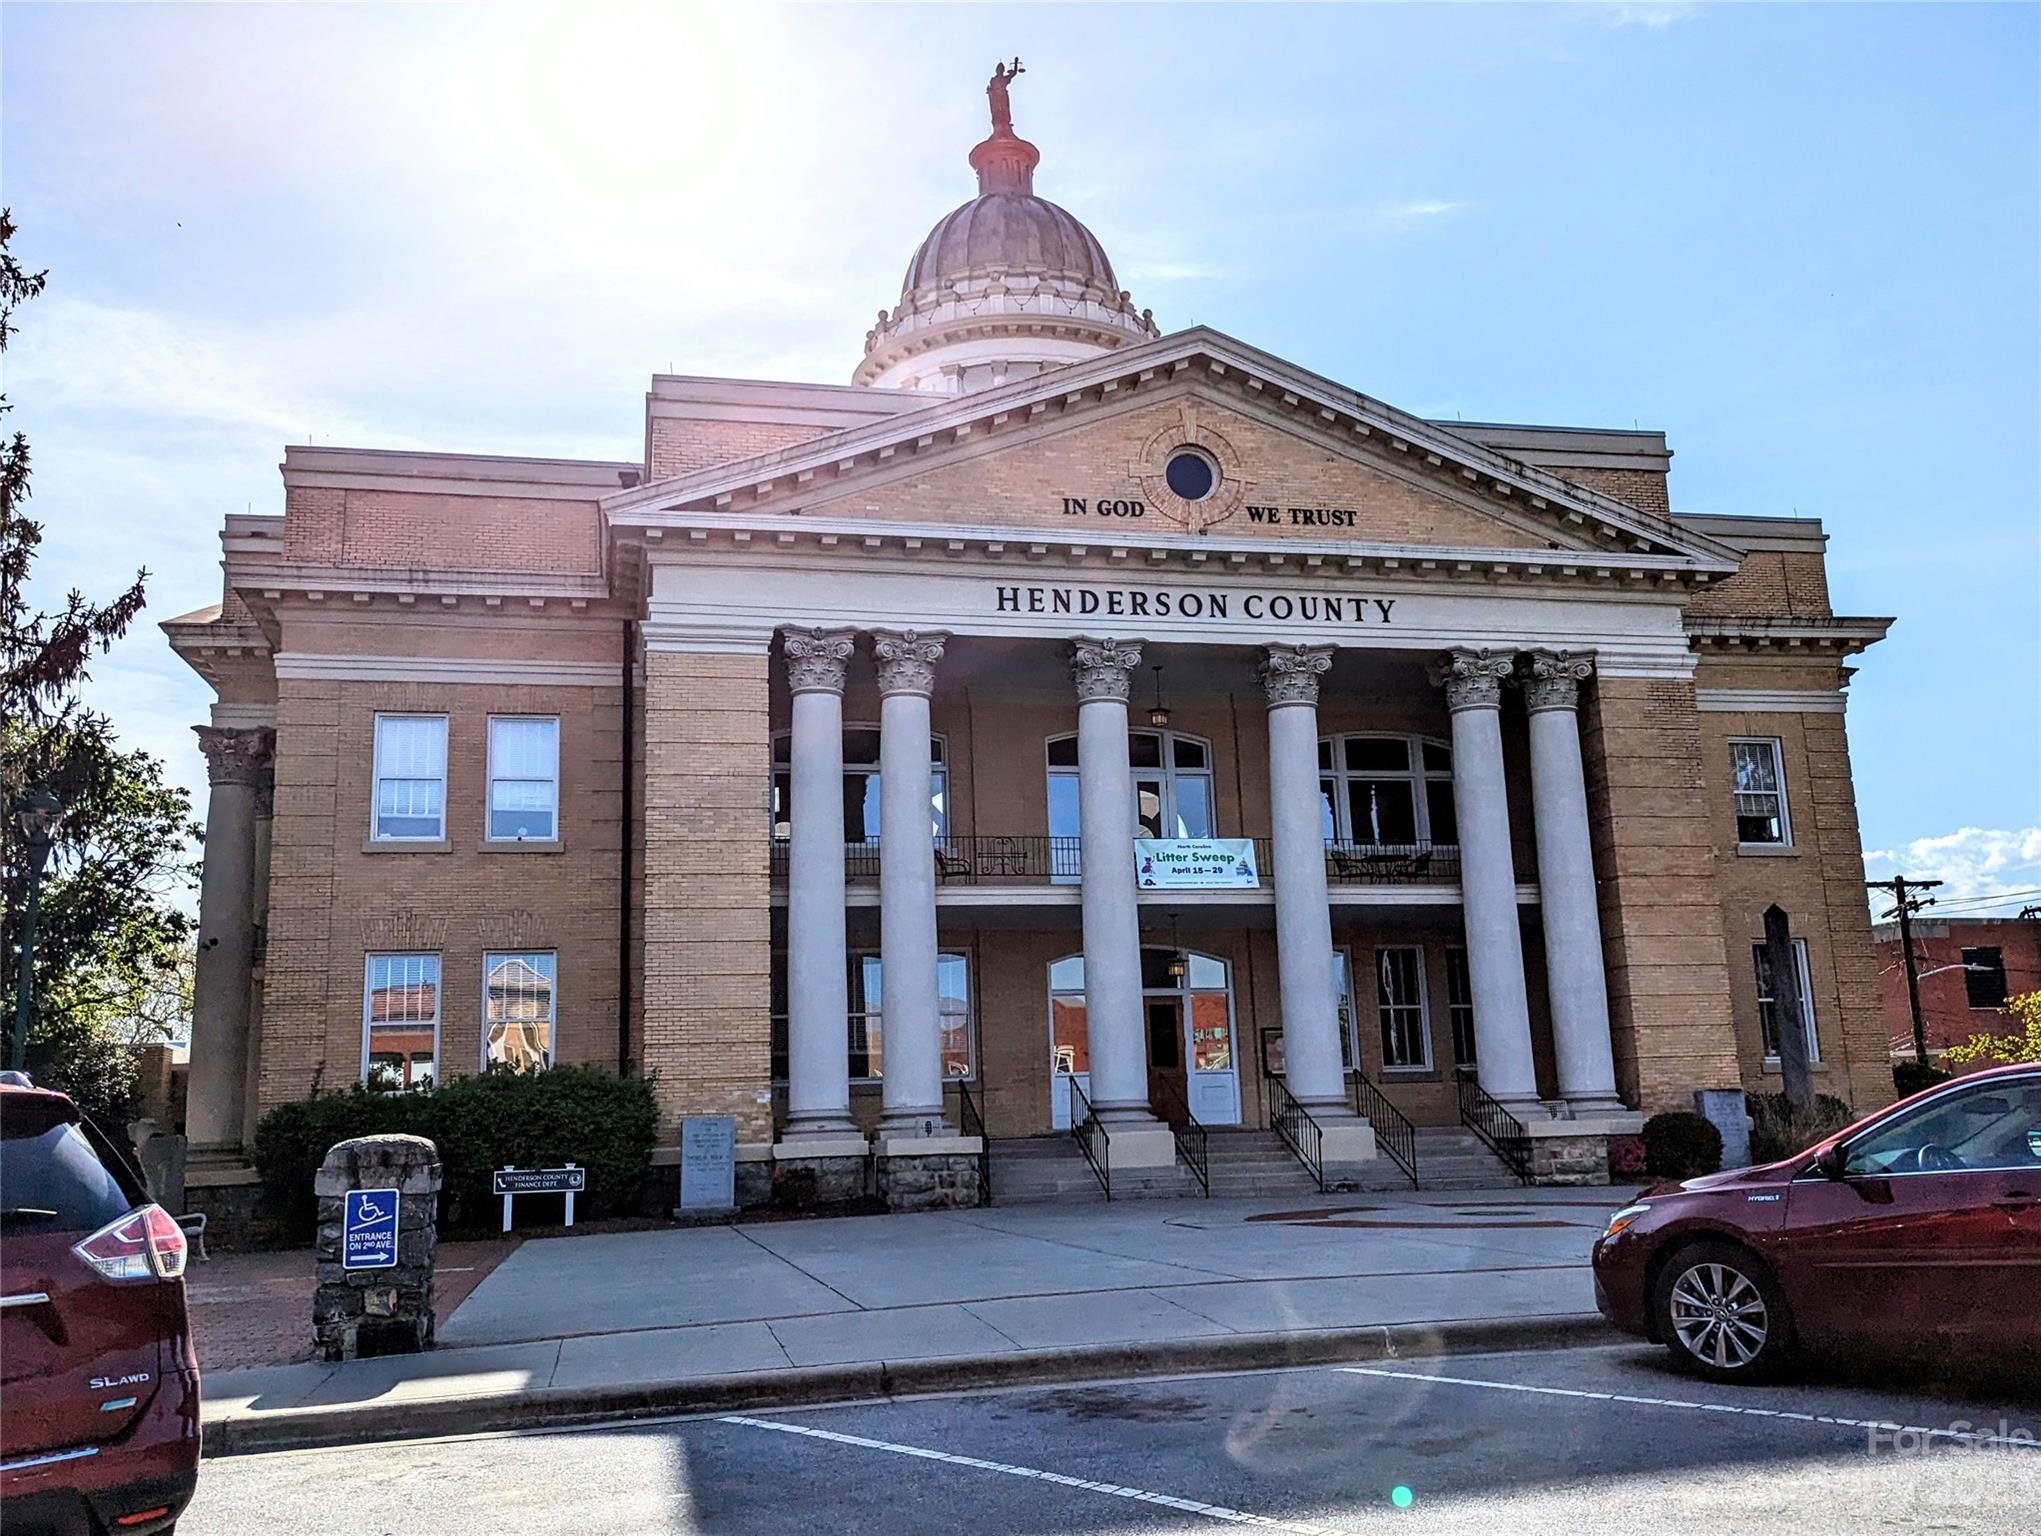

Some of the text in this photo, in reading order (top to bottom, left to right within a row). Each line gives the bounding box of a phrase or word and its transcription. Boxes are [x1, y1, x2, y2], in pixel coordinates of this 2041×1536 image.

[1062, 498, 1145, 518] IN GOD
[1246, 506, 1357, 527] WE TRUST
[996, 586, 1396, 624] HENDERSON COUNTY
[1156, 852, 1235, 864] Litter Sweep
[1171, 867, 1191, 875] April
[349, 1231, 393, 1242] ENTRANCE
[349, 1242, 361, 1251] ON
